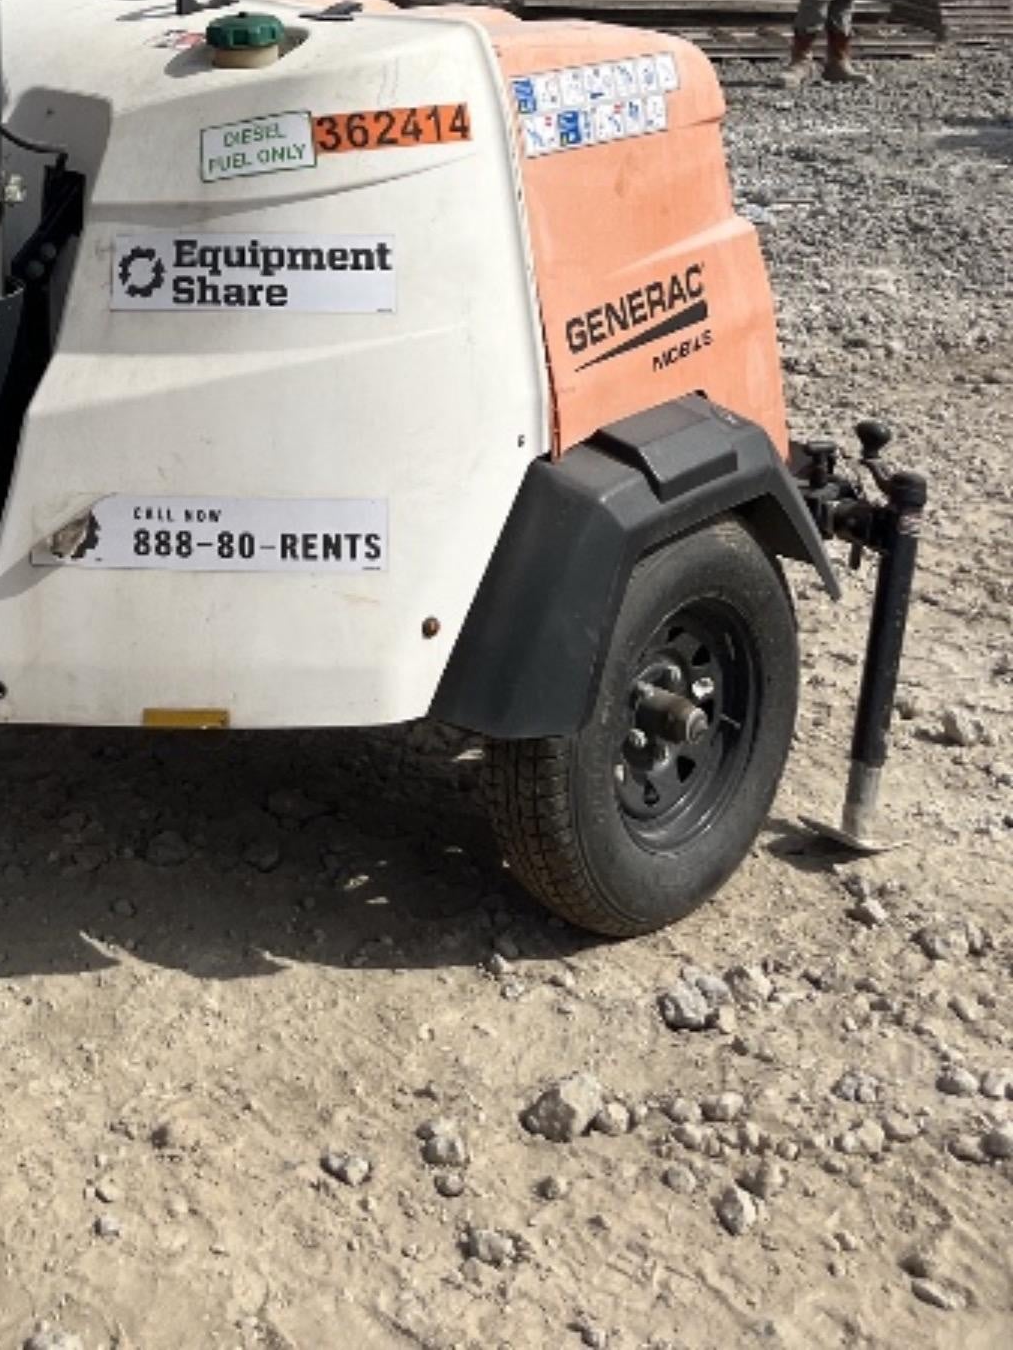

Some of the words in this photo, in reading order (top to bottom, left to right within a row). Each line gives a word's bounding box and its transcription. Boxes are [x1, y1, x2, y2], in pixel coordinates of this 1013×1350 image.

[223, 122, 286, 147] DIESEL
[316, 103, 471, 152] 362414
[208, 153, 252, 174] FUEL
[256, 143, 307, 164] ONLY
[172, 239, 393, 276] Equipment
[172, 275, 289, 307] Share
[565, 263, 706, 355] GENERAC
[133, 506, 175, 522] CALL
[133, 528, 382, 561] 888-80-RENTS
